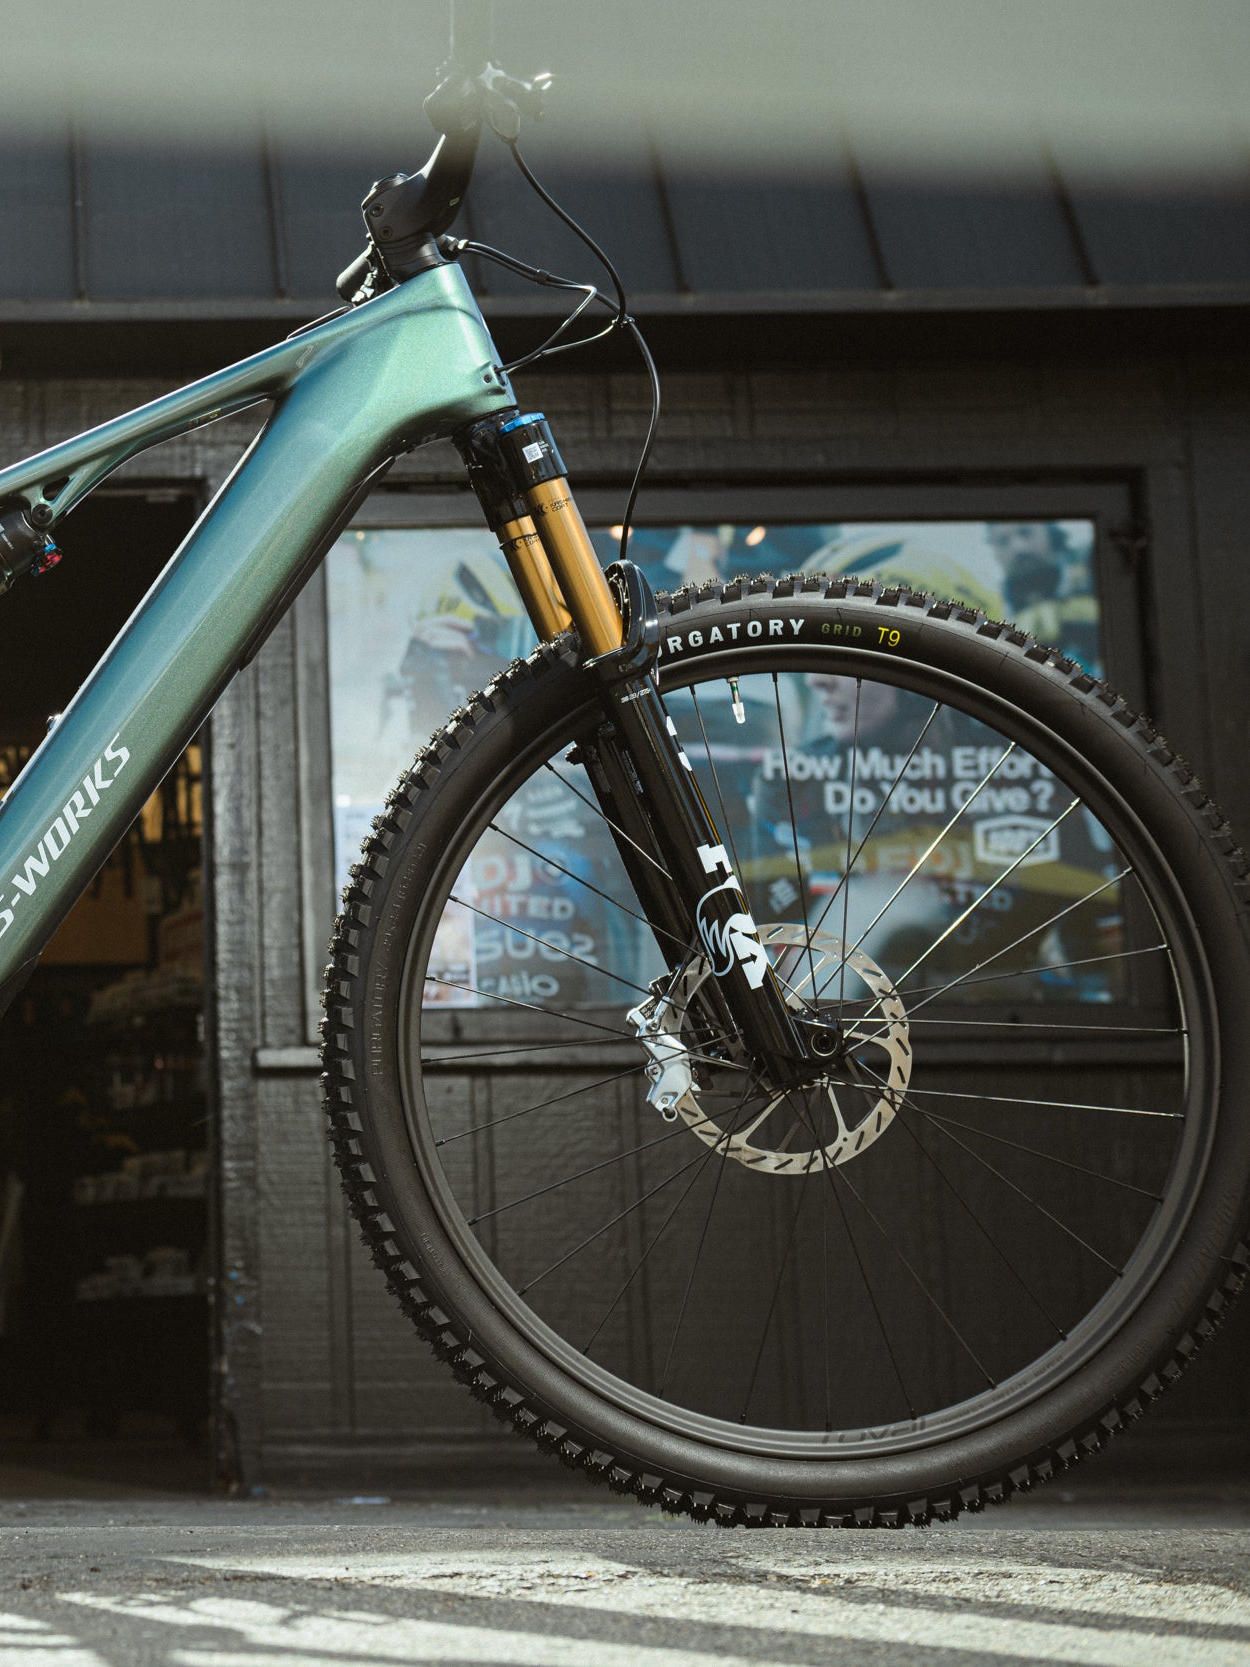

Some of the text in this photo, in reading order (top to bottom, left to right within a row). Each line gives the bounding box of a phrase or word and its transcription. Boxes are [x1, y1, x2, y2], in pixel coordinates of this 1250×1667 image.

[657, 618, 901, 659] RGATORY GRID T9
[763, 752, 843, 781] How
[855, 746, 947, 779] Much
[824, 780, 1055, 815] Do You Give?
